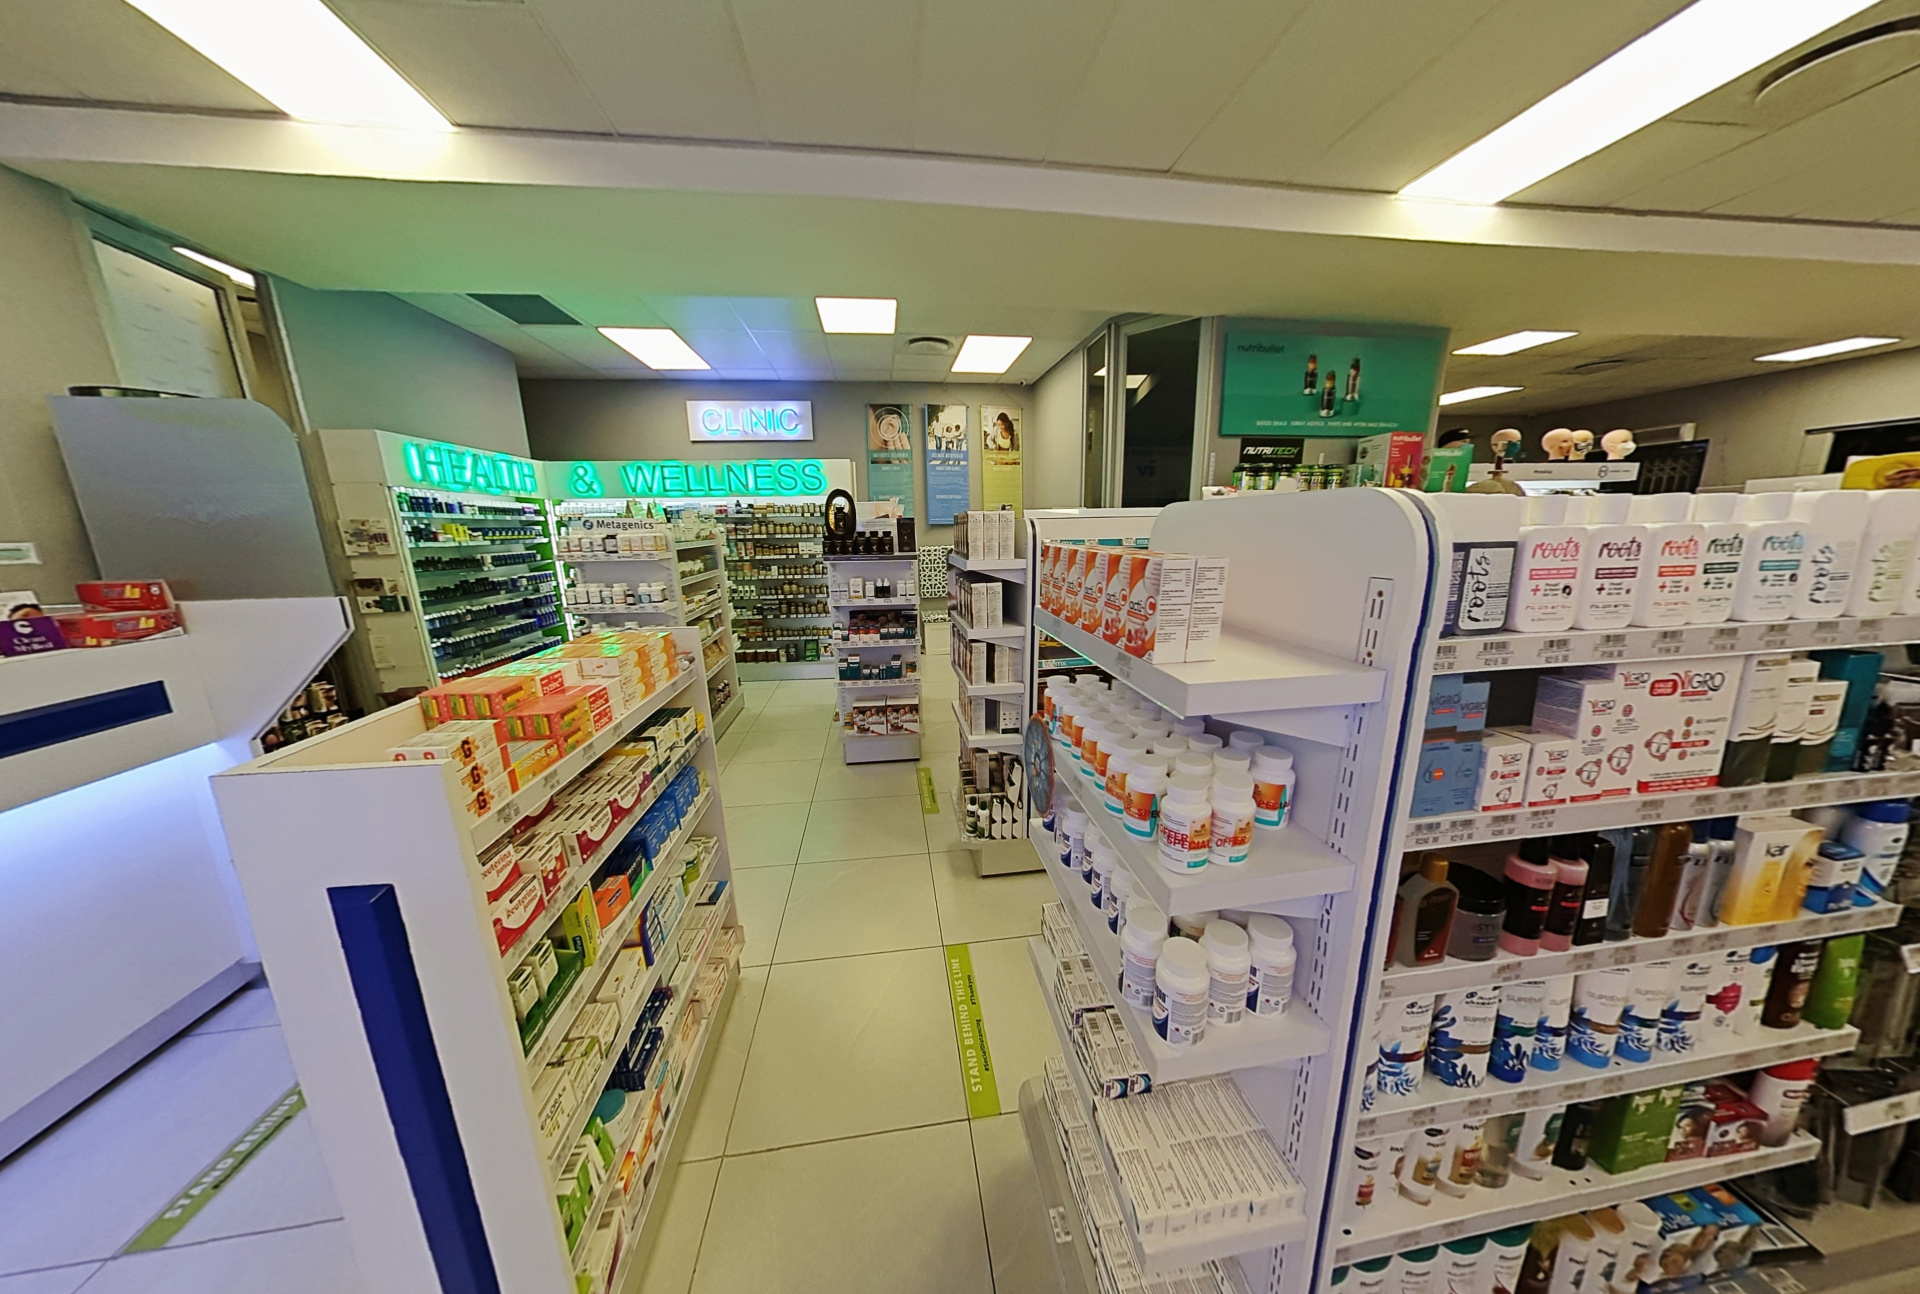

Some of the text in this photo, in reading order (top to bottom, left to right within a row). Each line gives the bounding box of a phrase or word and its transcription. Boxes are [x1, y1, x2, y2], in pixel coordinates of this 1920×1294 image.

[1237, 342, 1285, 354] nutribullet
[701, 407, 801, 435] CLINIC
[408, 443, 826, 496] HEALTH & WELLNESS
[596, 519, 655, 531] Metagenics
[1531, 536, 1582, 560] roots
[1597, 536, 1643, 560] roots
[1661, 535, 1700, 557] roots
[1706, 532, 1744, 555] roots
[1761, 530, 1806, 551] roots
[1466, 552, 1491, 623] roots
[461, 739, 472, 759] G
[470, 765, 481, 785] G
[476, 791, 488, 811] G
[1159, 823, 1190, 843] OFFER
[1166, 834, 1213, 852] SPECIAL
[1215, 835, 1247, 848] OFFER
[505, 885, 537, 920] Reuterina
[950, 957, 983, 1093] STAND BEHIND THIS LINE
[163, 1157, 235, 1219] STAND
[232, 1094, 299, 1153] BEHIND
